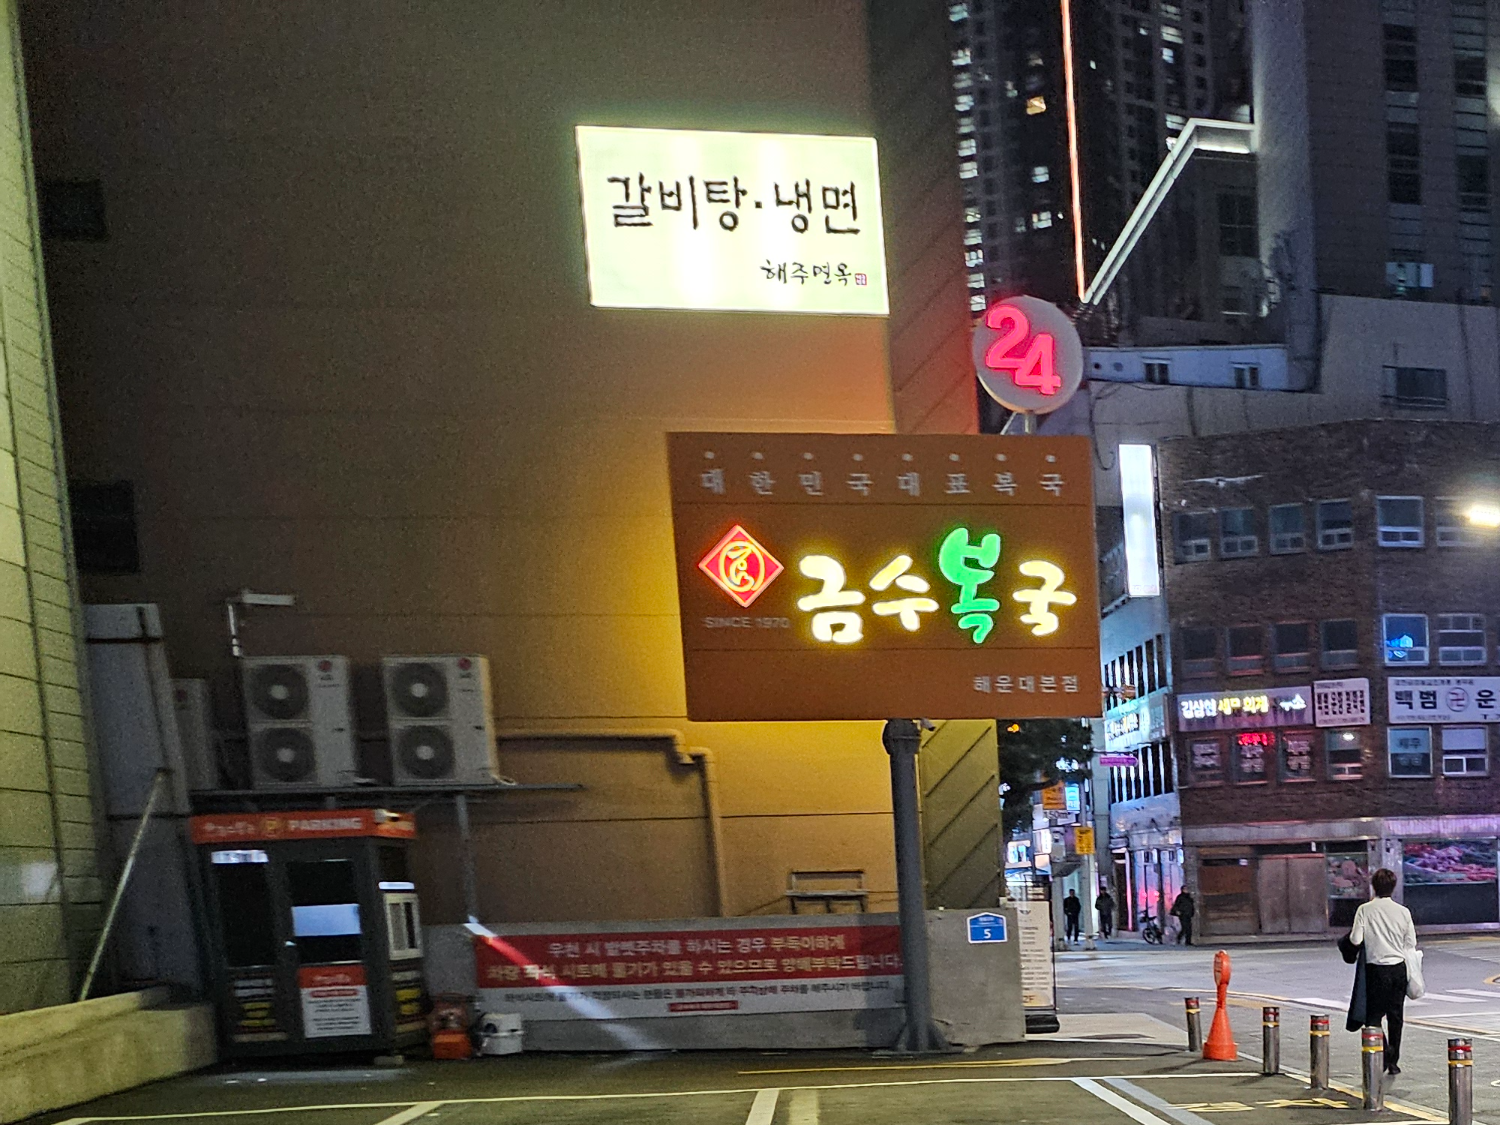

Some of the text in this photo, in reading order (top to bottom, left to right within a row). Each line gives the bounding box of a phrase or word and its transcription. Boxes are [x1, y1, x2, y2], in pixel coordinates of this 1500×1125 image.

[985, 304, 1062, 395] 24
[797, 527, 1077, 644] 금수복국
[705, 616, 790, 629] SINCE 1970
[974, 675, 1079, 694] 해운대본점
[983, 928, 992, 939] 5
[736, 937, 767, 953] 경우
[699, 961, 714, 976] 수
